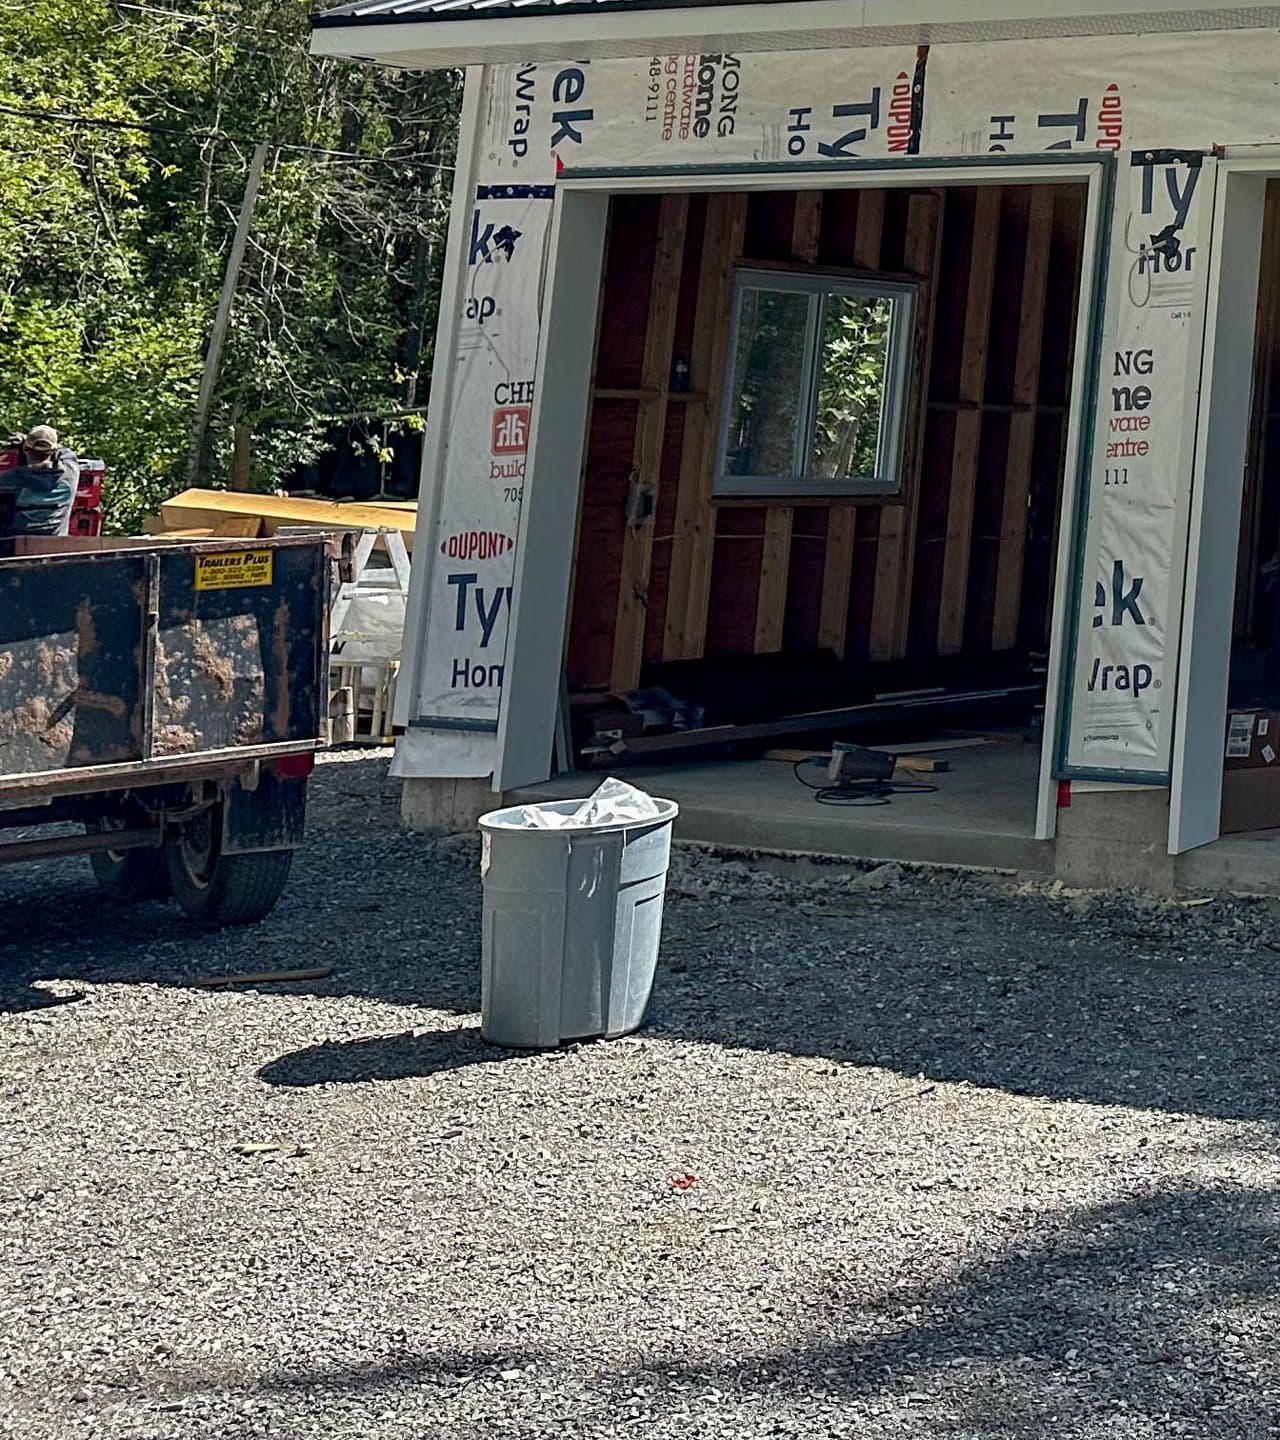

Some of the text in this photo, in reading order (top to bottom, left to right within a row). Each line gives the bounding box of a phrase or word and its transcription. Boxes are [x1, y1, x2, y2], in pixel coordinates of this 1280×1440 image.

[508, 62, 537, 158] Wrap
[550, 60, 594, 148] ek
[447, 531, 506, 560] DUPONT
[447, 573, 513, 649] Ty
